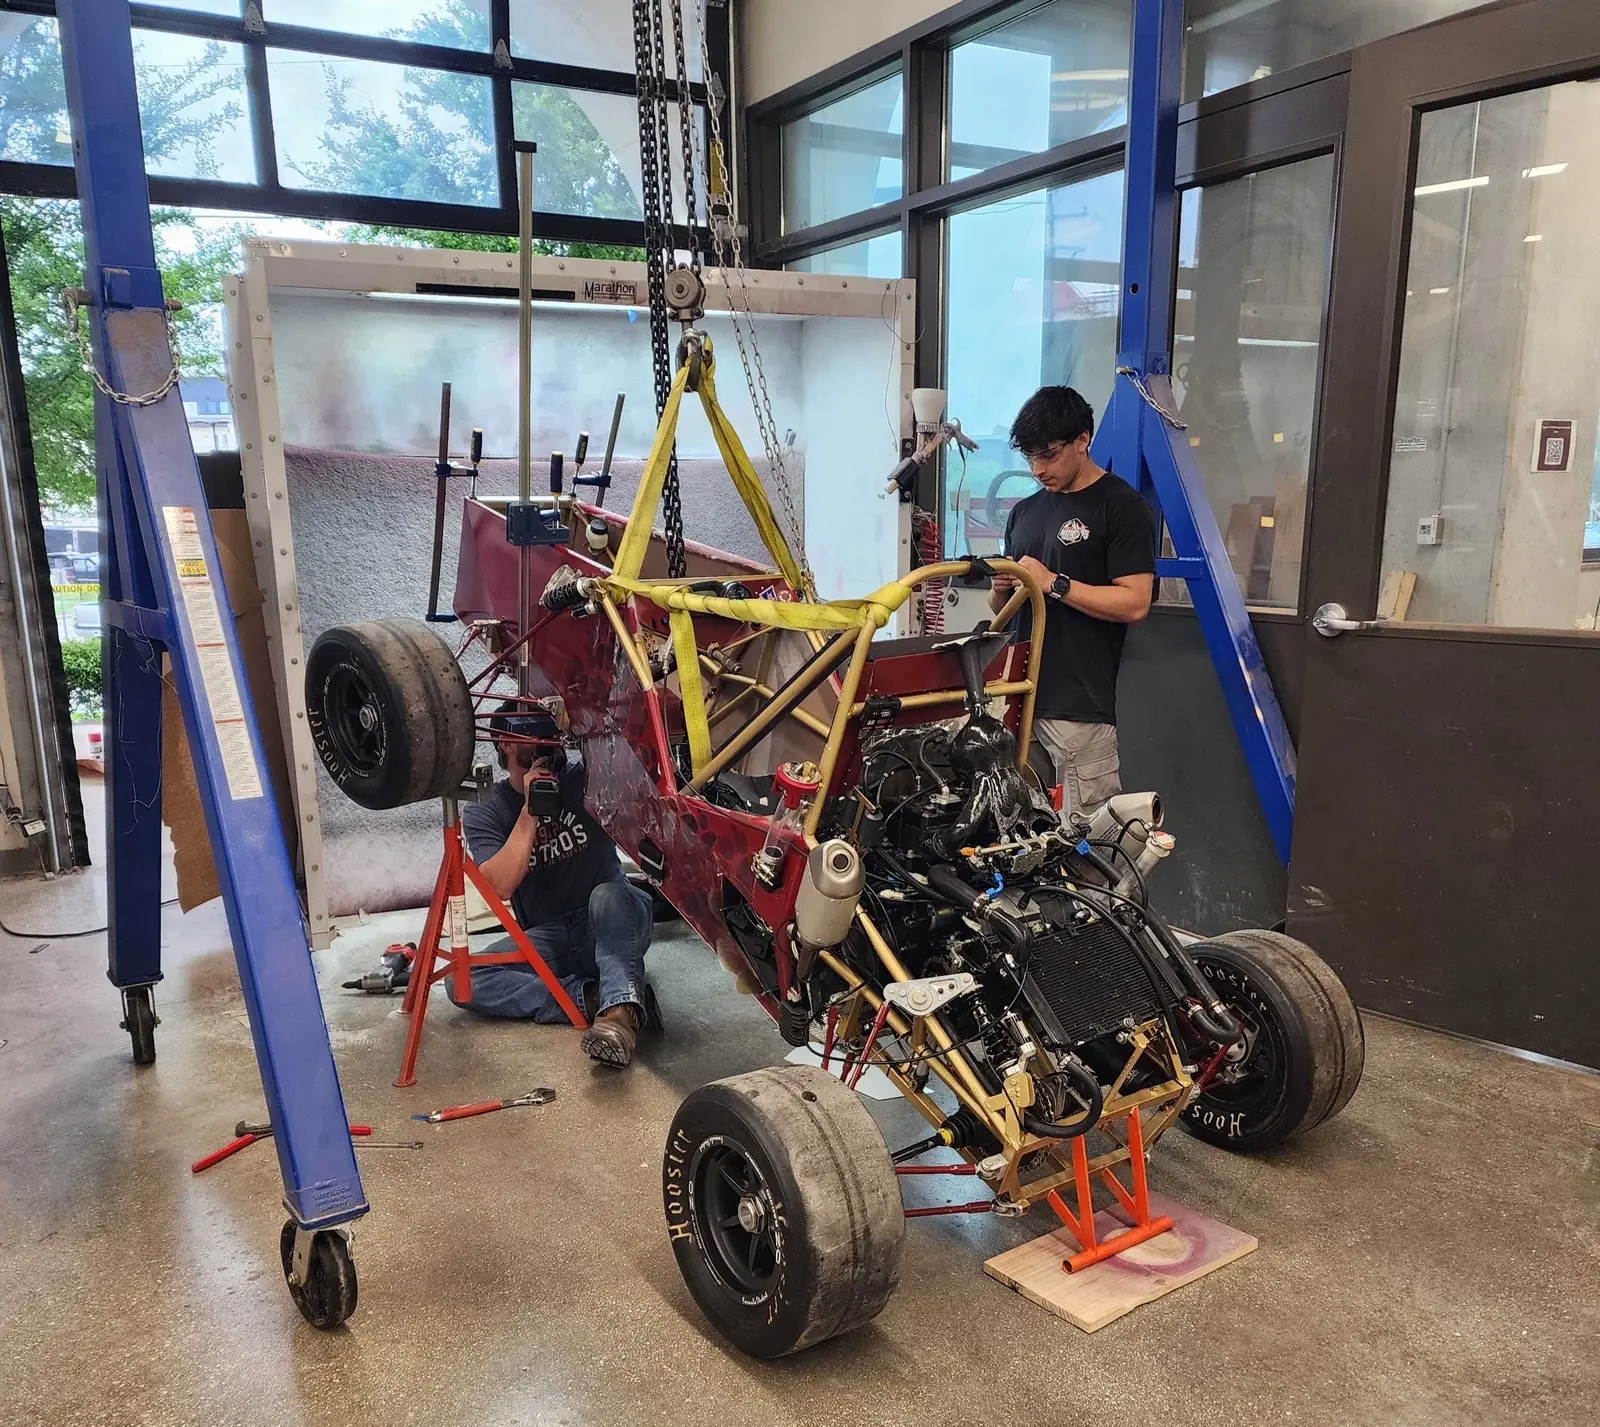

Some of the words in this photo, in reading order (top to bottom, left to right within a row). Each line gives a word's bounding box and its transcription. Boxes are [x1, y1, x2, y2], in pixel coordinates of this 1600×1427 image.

[584, 280, 635, 300] Marathon
[52, 585, 82, 593] AUTION
[528, 823, 588, 868] STROS
[1202, 963, 1268, 1012] oosier
[1191, 1104, 1246, 1137] Hoos
[666, 1128, 693, 1244] Hoosier
